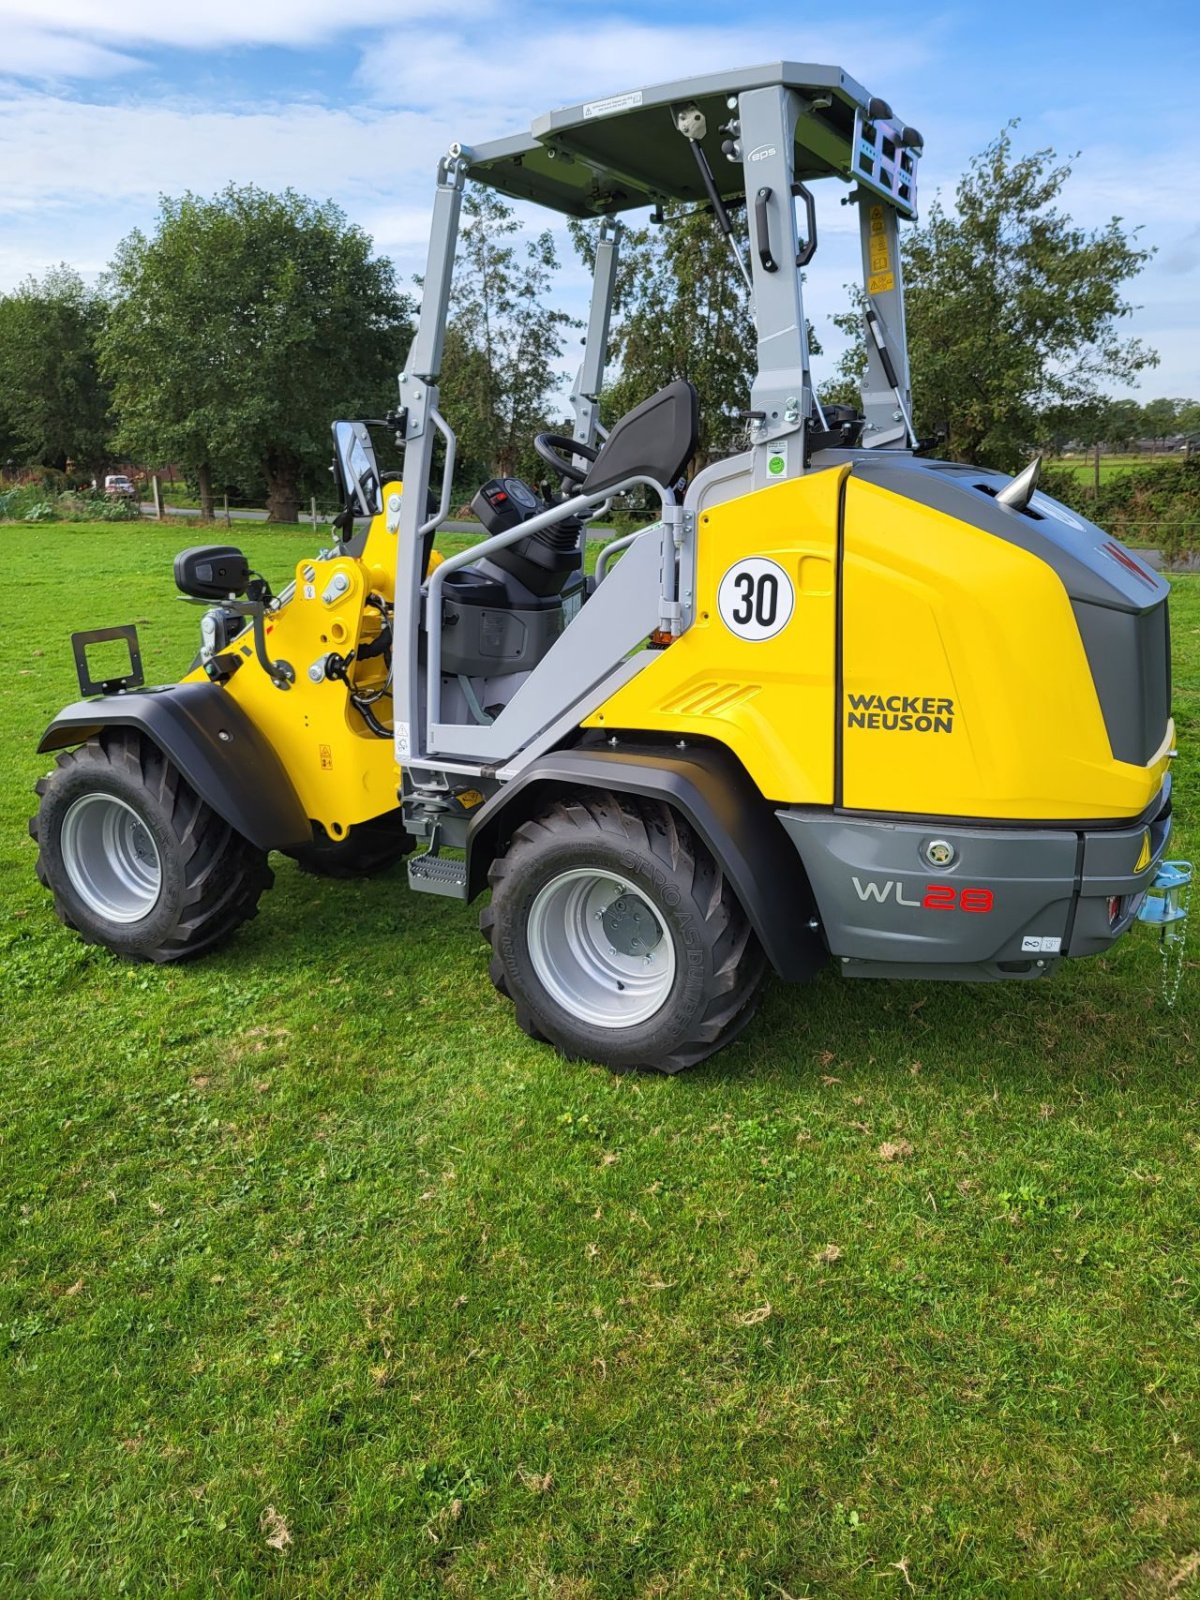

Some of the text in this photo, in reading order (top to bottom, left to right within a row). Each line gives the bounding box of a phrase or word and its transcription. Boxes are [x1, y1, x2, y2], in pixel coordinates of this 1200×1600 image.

[751, 147, 776, 161] eps
[732, 572, 779, 627] 30
[847, 694, 955, 716] WACKER
[847, 712, 953, 734] NEUSON
[851, 876, 994, 913] WL28
